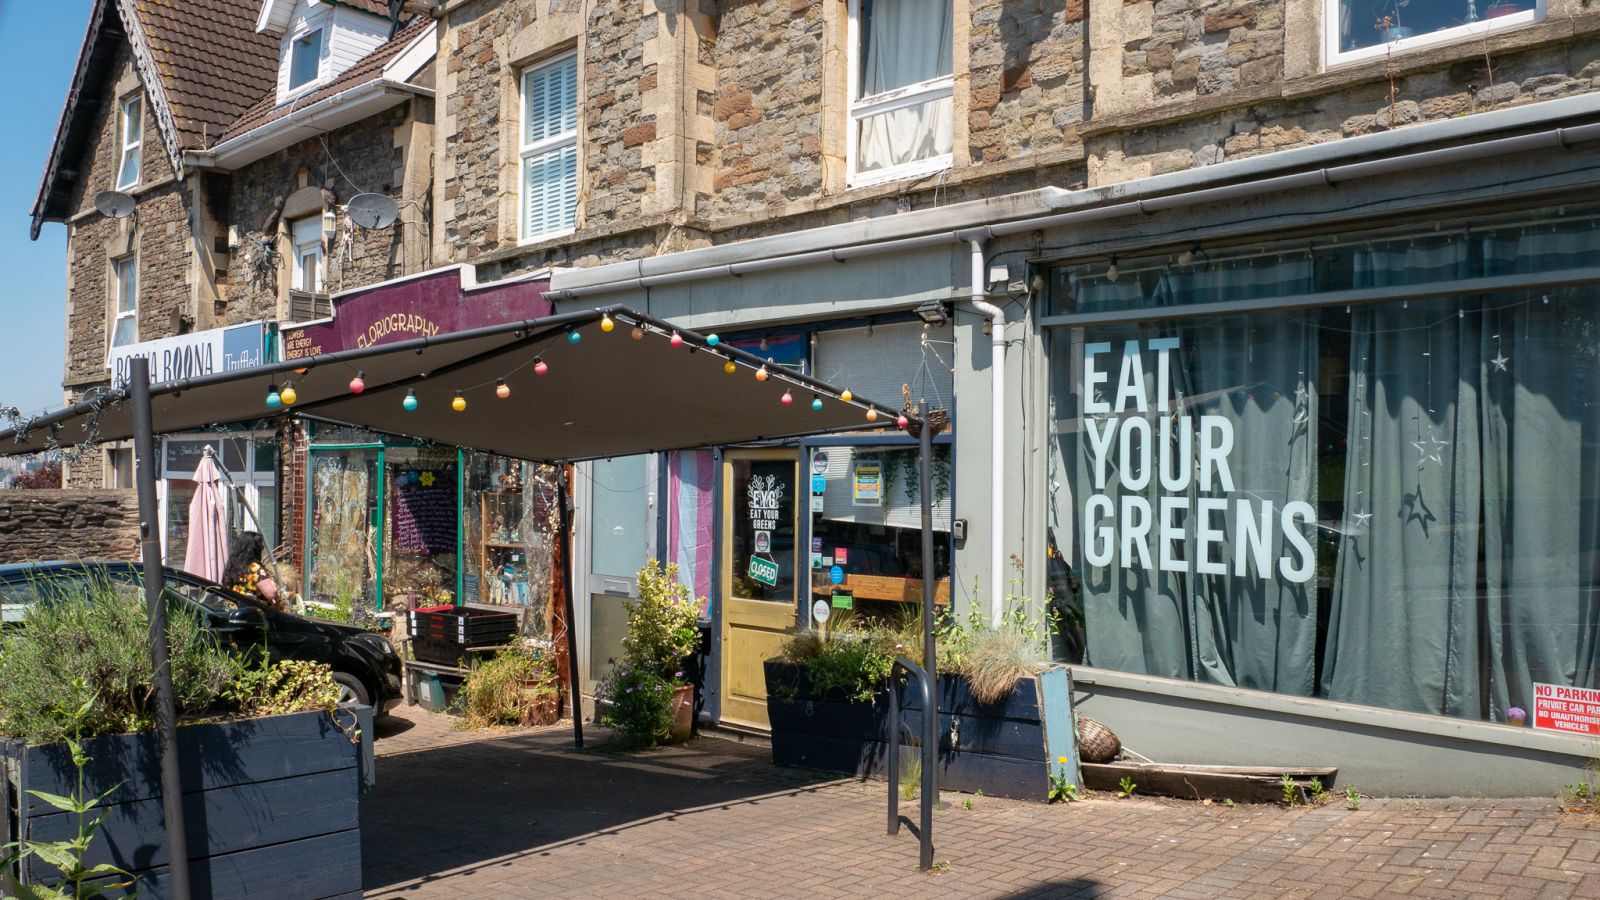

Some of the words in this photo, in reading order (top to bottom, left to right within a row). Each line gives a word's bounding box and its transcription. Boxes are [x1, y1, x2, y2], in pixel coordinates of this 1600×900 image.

[357, 313, 439, 349] FLORIOGRAPHY
[287, 341, 295, 349] ARE
[295, 338, 312, 348] ENERGY
[287, 348, 303, 359] ENERGY
[305, 348, 310, 356] IS
[310, 345, 322, 355] LOVE
[164, 342, 213, 382] BOONA
[225, 348, 259, 372] Truffled
[1084, 337, 1180, 413] EAT
[1084, 415, 1235, 492] YOUR
[750, 509, 761, 519] EAT
[763, 510, 779, 520] YOUR
[753, 519, 776, 530] GREENS
[1084, 494, 1316, 583] GREENS
[751, 562, 776, 580] CLOSED
[1536, 685, 1552, 697] NO
[1538, 699, 1567, 711] PRIVATE
[1569, 703, 1585, 713] CAR
[1538, 710, 1549, 718] NO
[1555, 720, 1589, 732] VEHICLES
